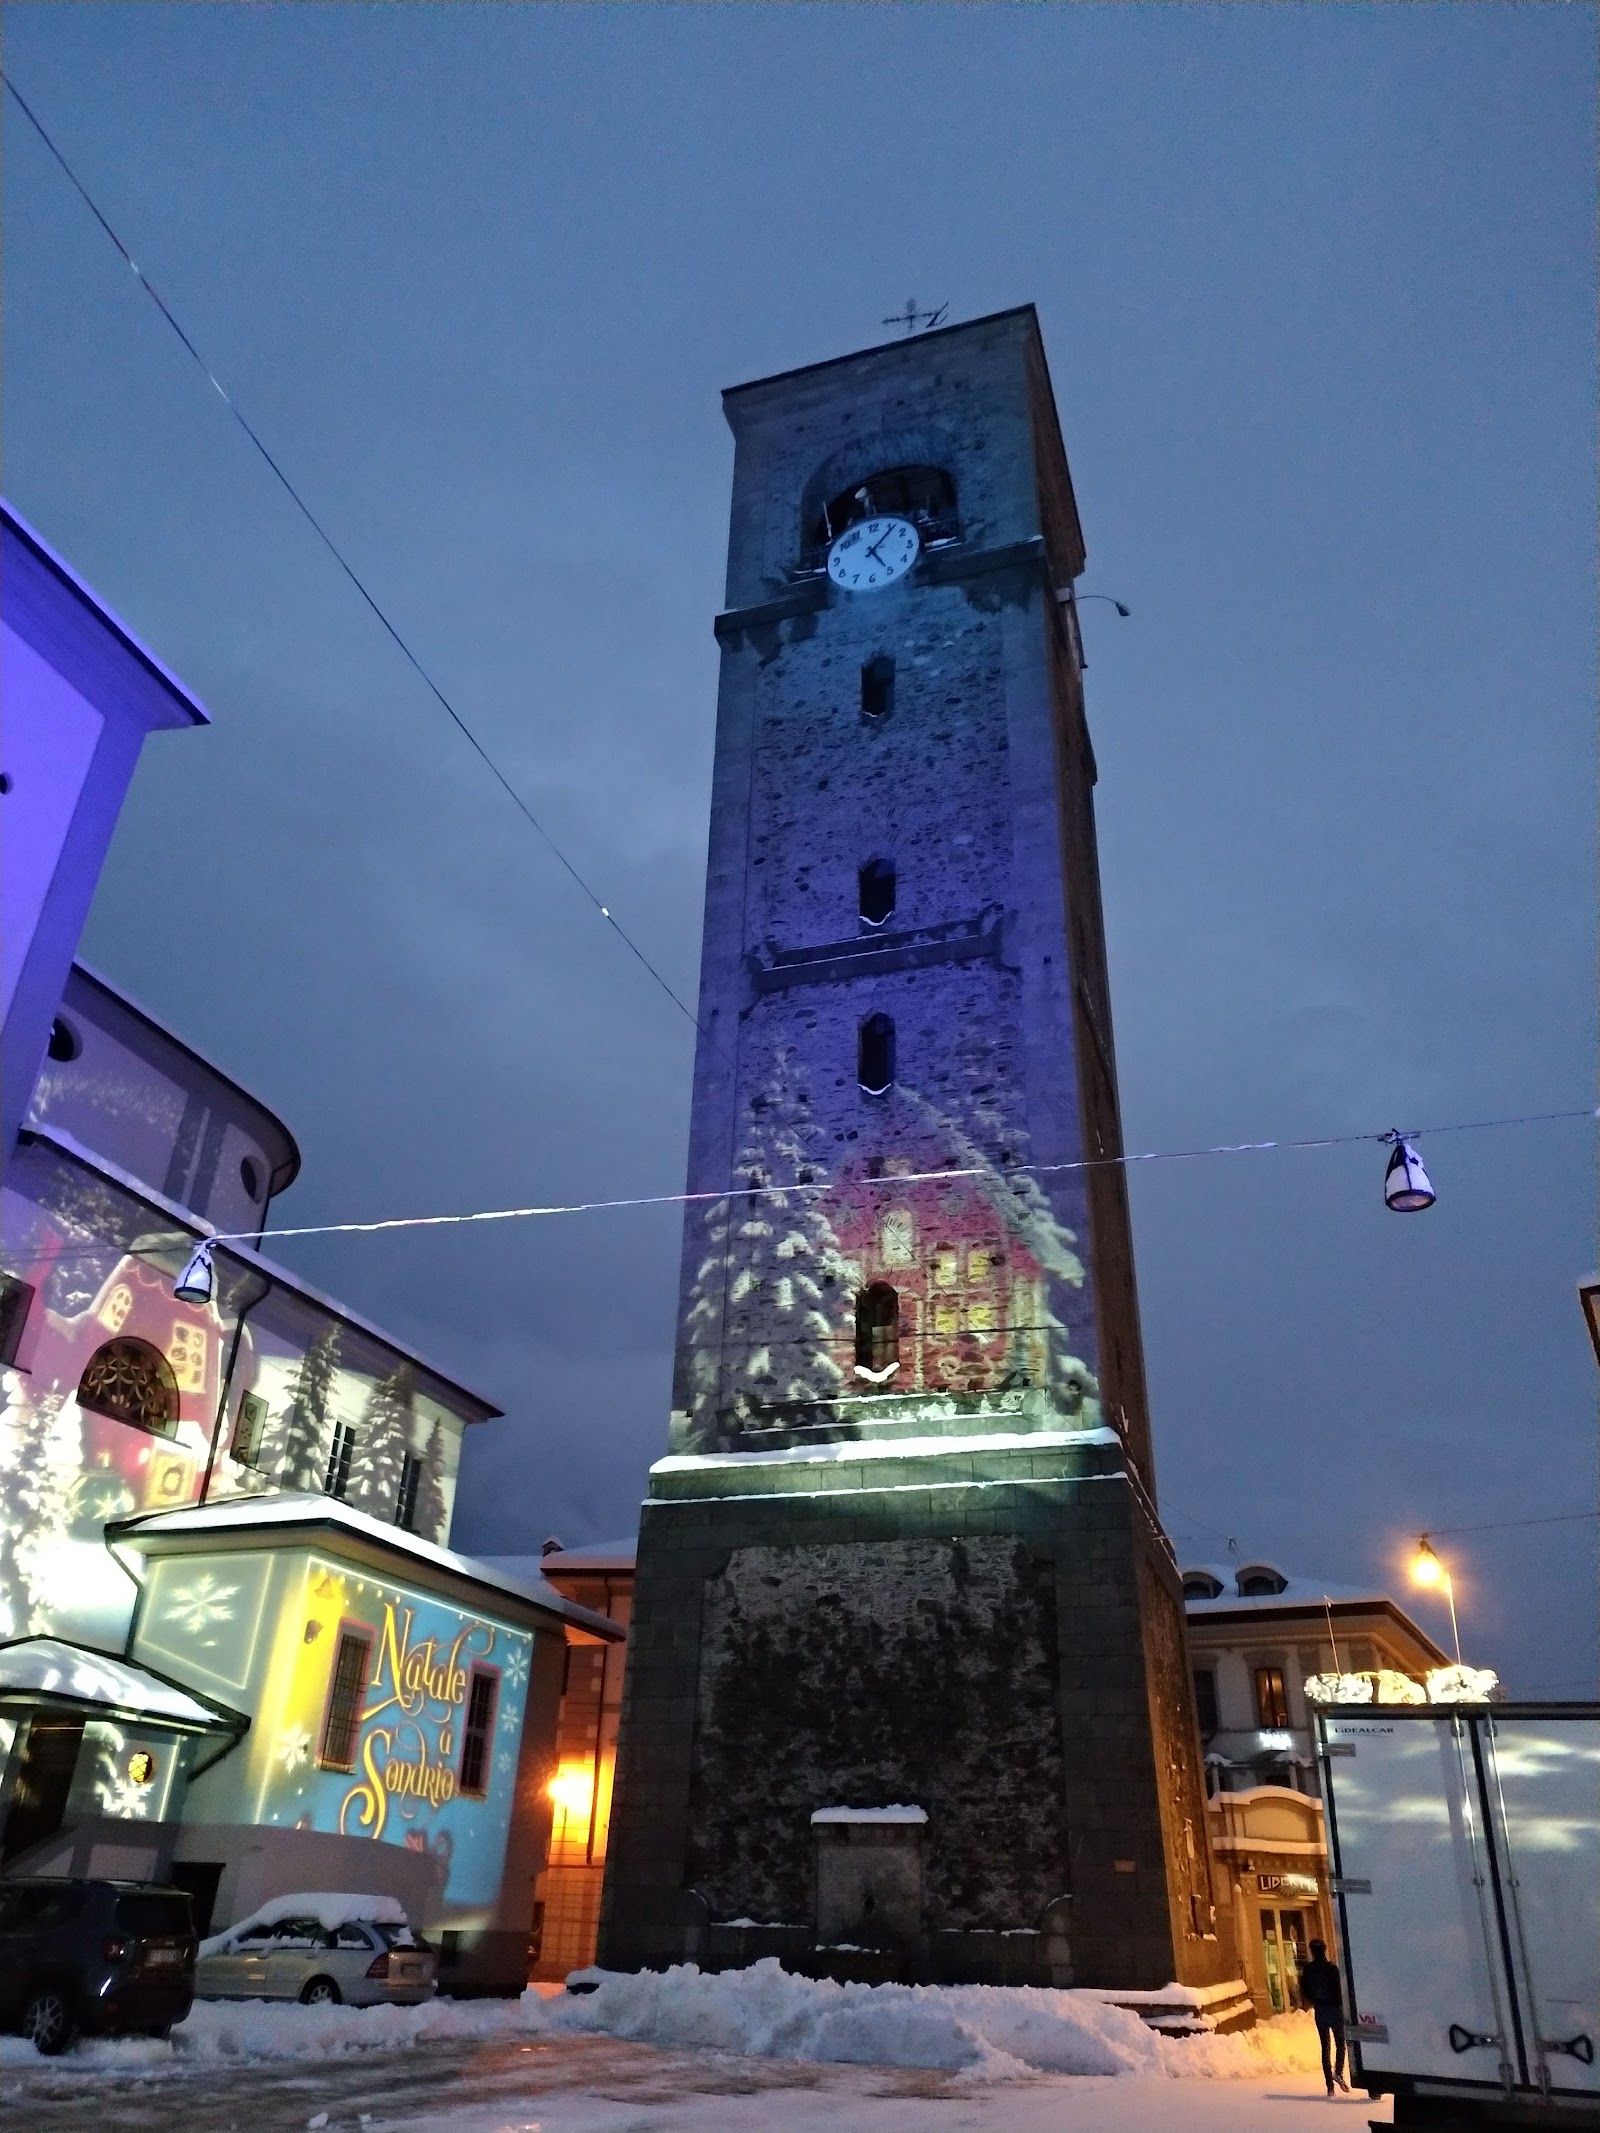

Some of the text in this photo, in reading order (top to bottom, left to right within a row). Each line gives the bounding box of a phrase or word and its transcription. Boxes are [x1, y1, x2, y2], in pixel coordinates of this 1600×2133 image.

[867, 523, 879, 533] 12
[899, 528, 906, 537] 2
[851, 530, 860, 541] 11
[840, 541, 851, 552] 10
[906, 540, 913, 549] 3
[833, 557, 840, 567] 9
[900, 554, 907, 563] 4
[839, 569, 846, 578] 8
[887, 567, 894, 576] 5
[853, 574, 860, 584] 7
[869, 574, 876, 583] 6
[362, 1603, 493, 1723] Natale
[439, 1724, 453, 1755] a
[340, 1720, 455, 1839] Sondrio
